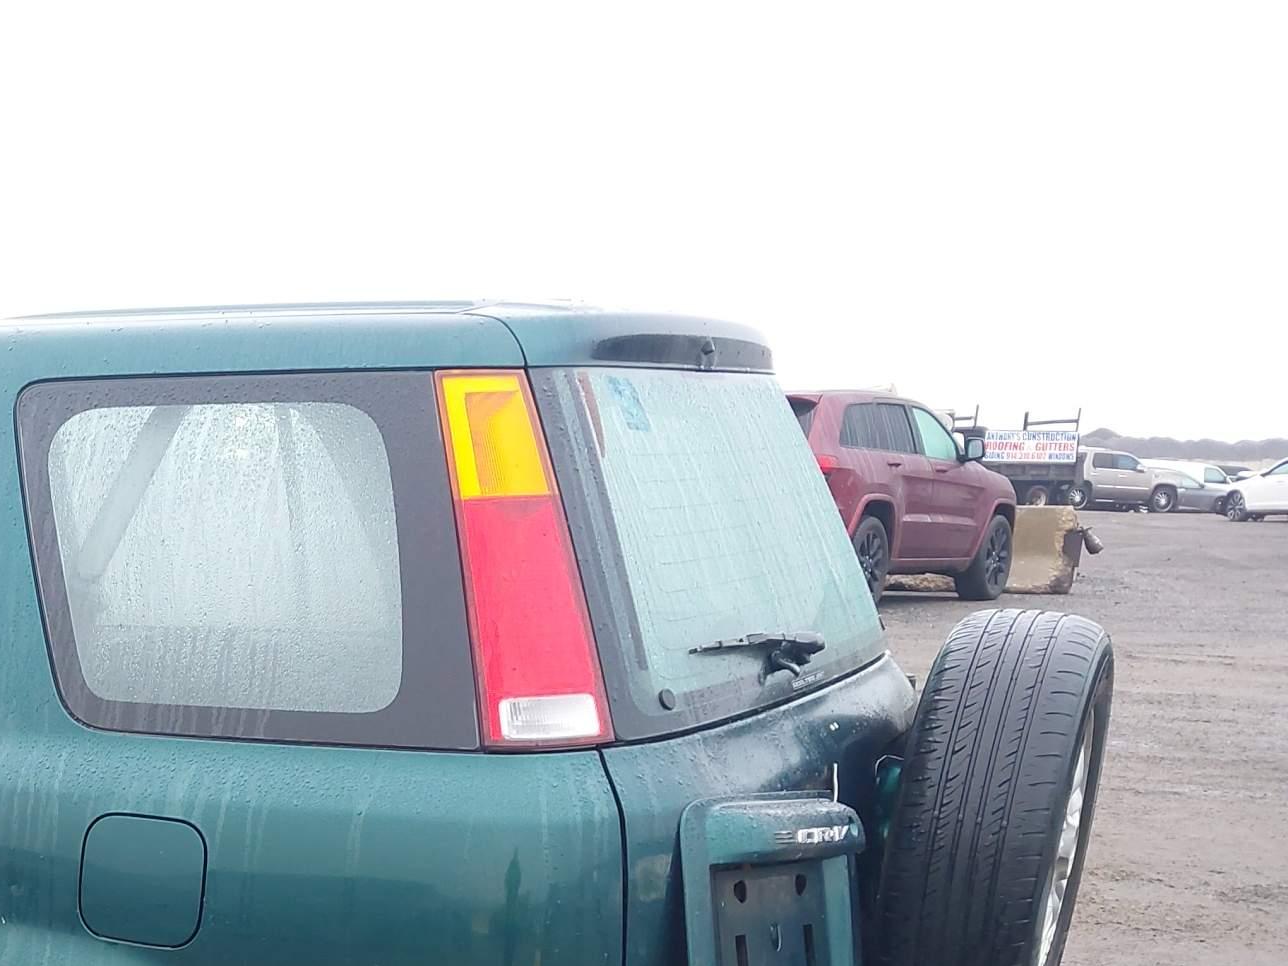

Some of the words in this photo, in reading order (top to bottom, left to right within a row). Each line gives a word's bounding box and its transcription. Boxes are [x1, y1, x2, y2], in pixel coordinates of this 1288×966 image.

[1022, 432, 1077, 442] CONSTRUCTION
[984, 441, 1025, 451] ROOFING
[1035, 442, 1075, 452] GUTTERS
[1048, 453, 1074, 461] WINDOWS
